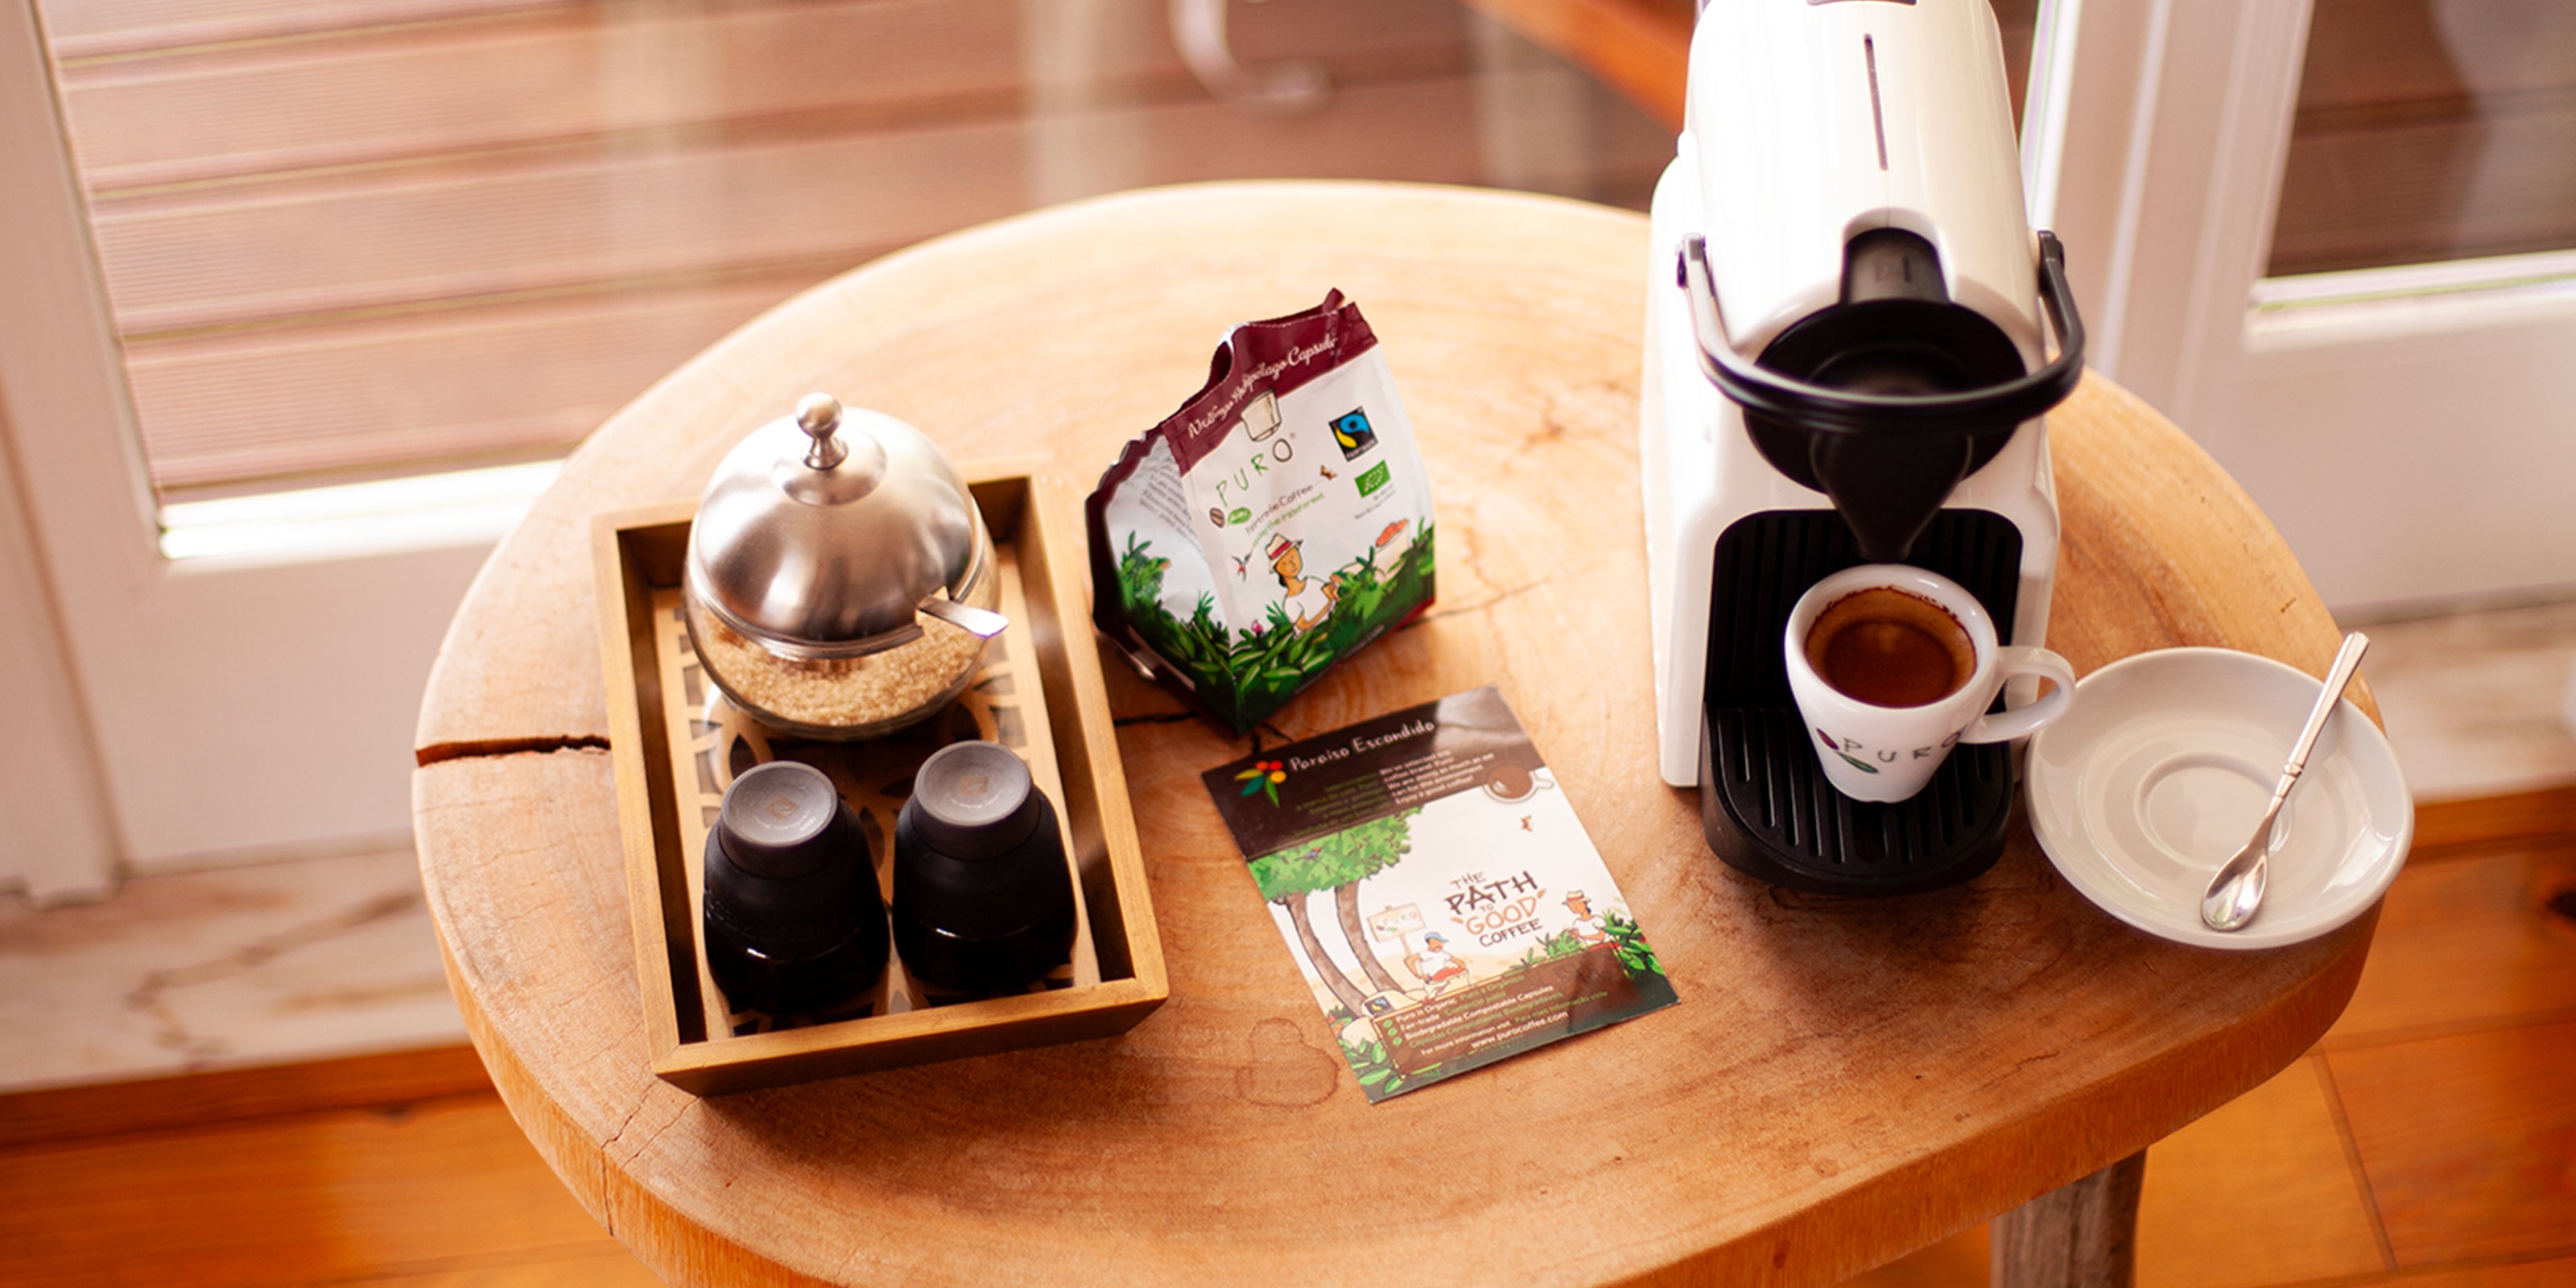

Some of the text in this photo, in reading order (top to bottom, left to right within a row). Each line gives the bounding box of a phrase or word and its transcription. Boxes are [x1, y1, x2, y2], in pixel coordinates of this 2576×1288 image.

[1216, 438, 1293, 507] PURO
[1352, 719, 1435, 753] Escondido
[1843, 731, 1962, 763] PURO
[1444, 870, 1538, 915] PATH
[1450, 871, 1487, 889] THE
[1465, 896, 1537, 935] GOOD
[1480, 903, 1494, 912] TO
[1479, 918, 1543, 947] COFFEE
[1463, 997, 1517, 1020] Compostable
[1471, 1010, 1569, 1049] www.purocoffee.com
